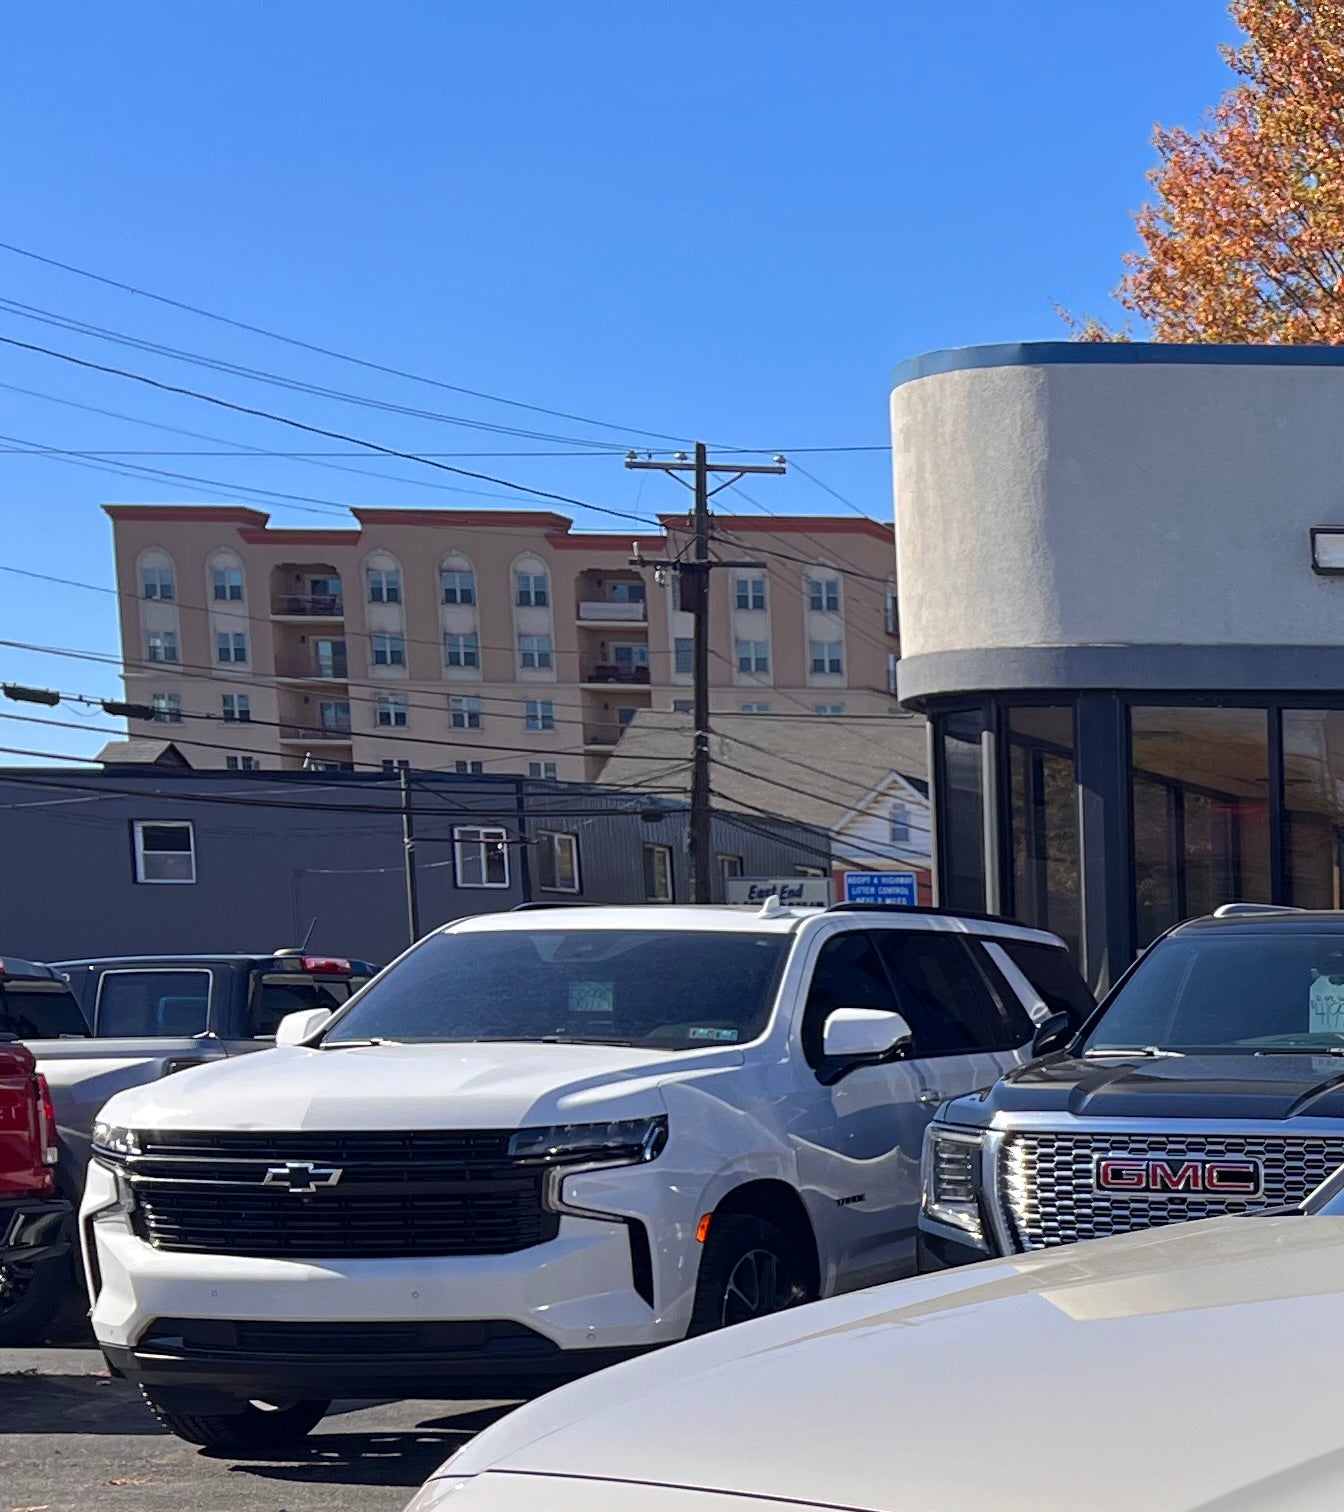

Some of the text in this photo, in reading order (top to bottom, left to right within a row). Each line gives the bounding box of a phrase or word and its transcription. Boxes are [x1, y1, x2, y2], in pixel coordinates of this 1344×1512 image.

[748, 883, 804, 900] East End
[851, 886, 875, 895] LITTER
[1100, 1161, 1254, 1191] GMC
